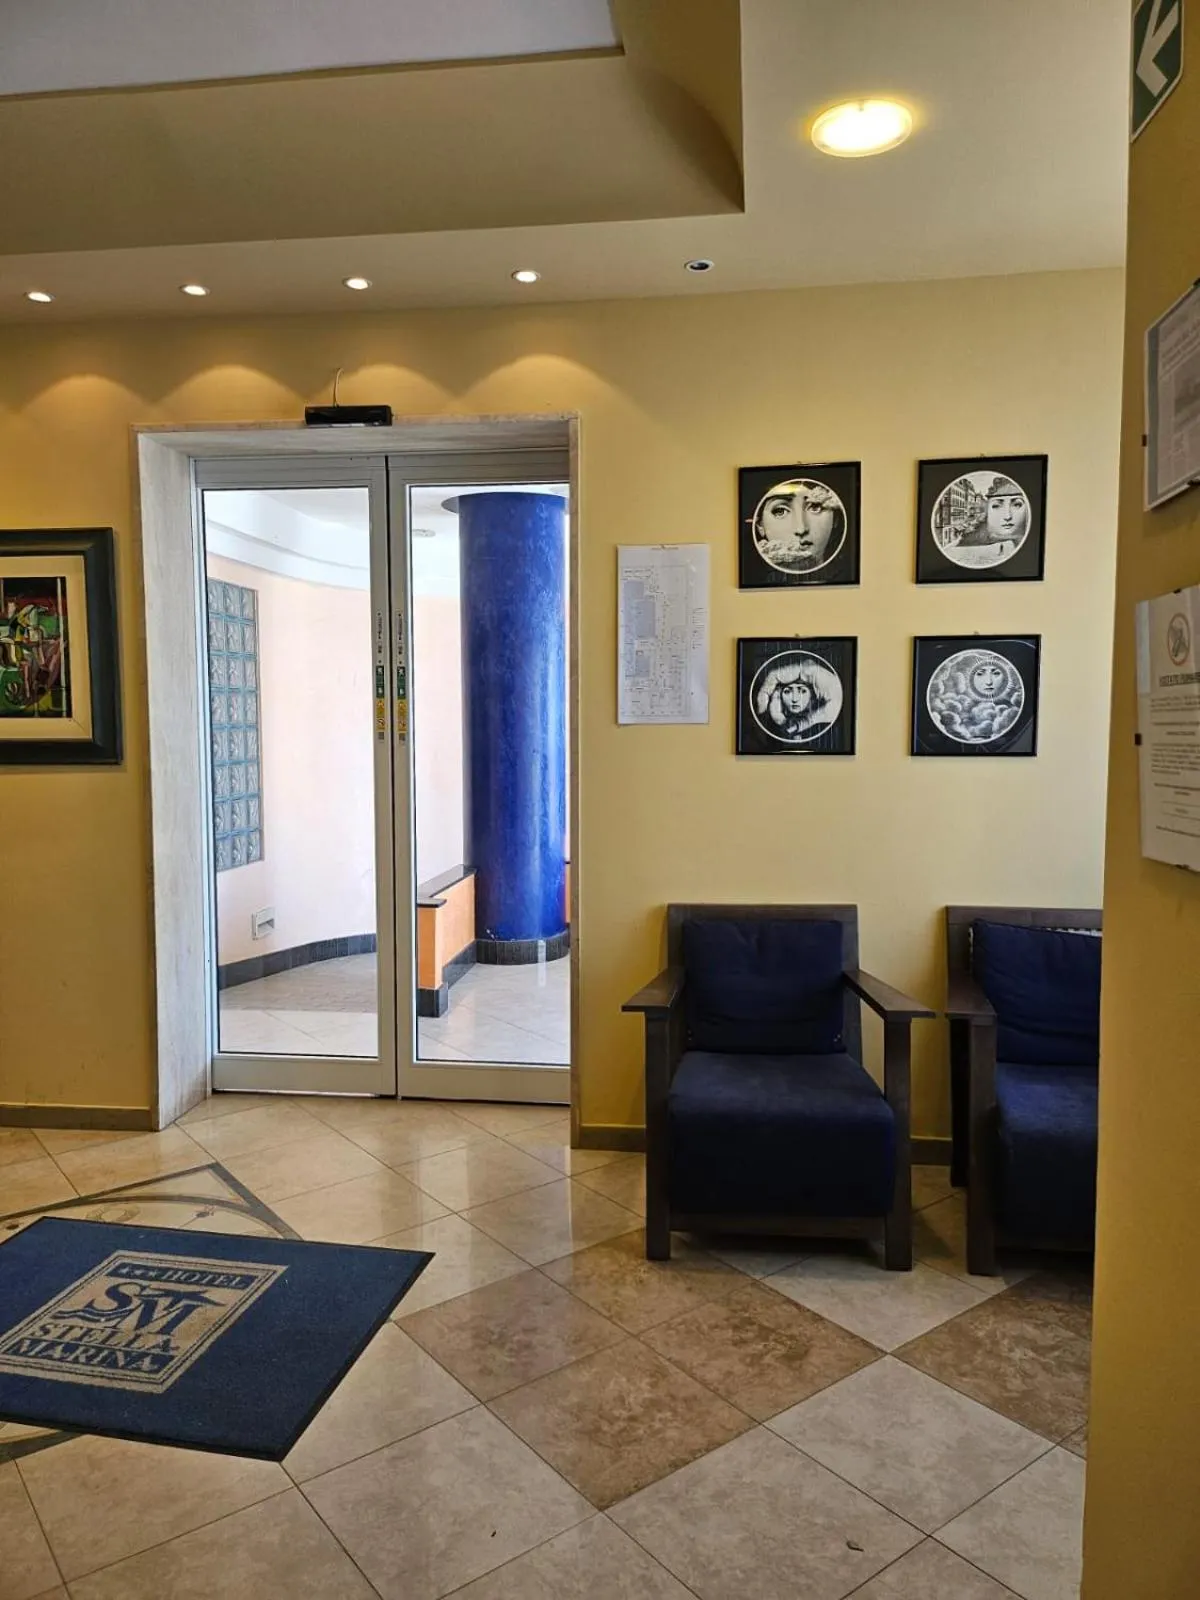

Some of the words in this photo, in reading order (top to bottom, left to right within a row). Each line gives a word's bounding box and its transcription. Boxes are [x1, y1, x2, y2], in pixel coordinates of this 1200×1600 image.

[159, 1269, 248, 1288] HOTEL
[29, 1323, 181, 1352] STELLA
[9, 1338, 159, 1371] MARINA
